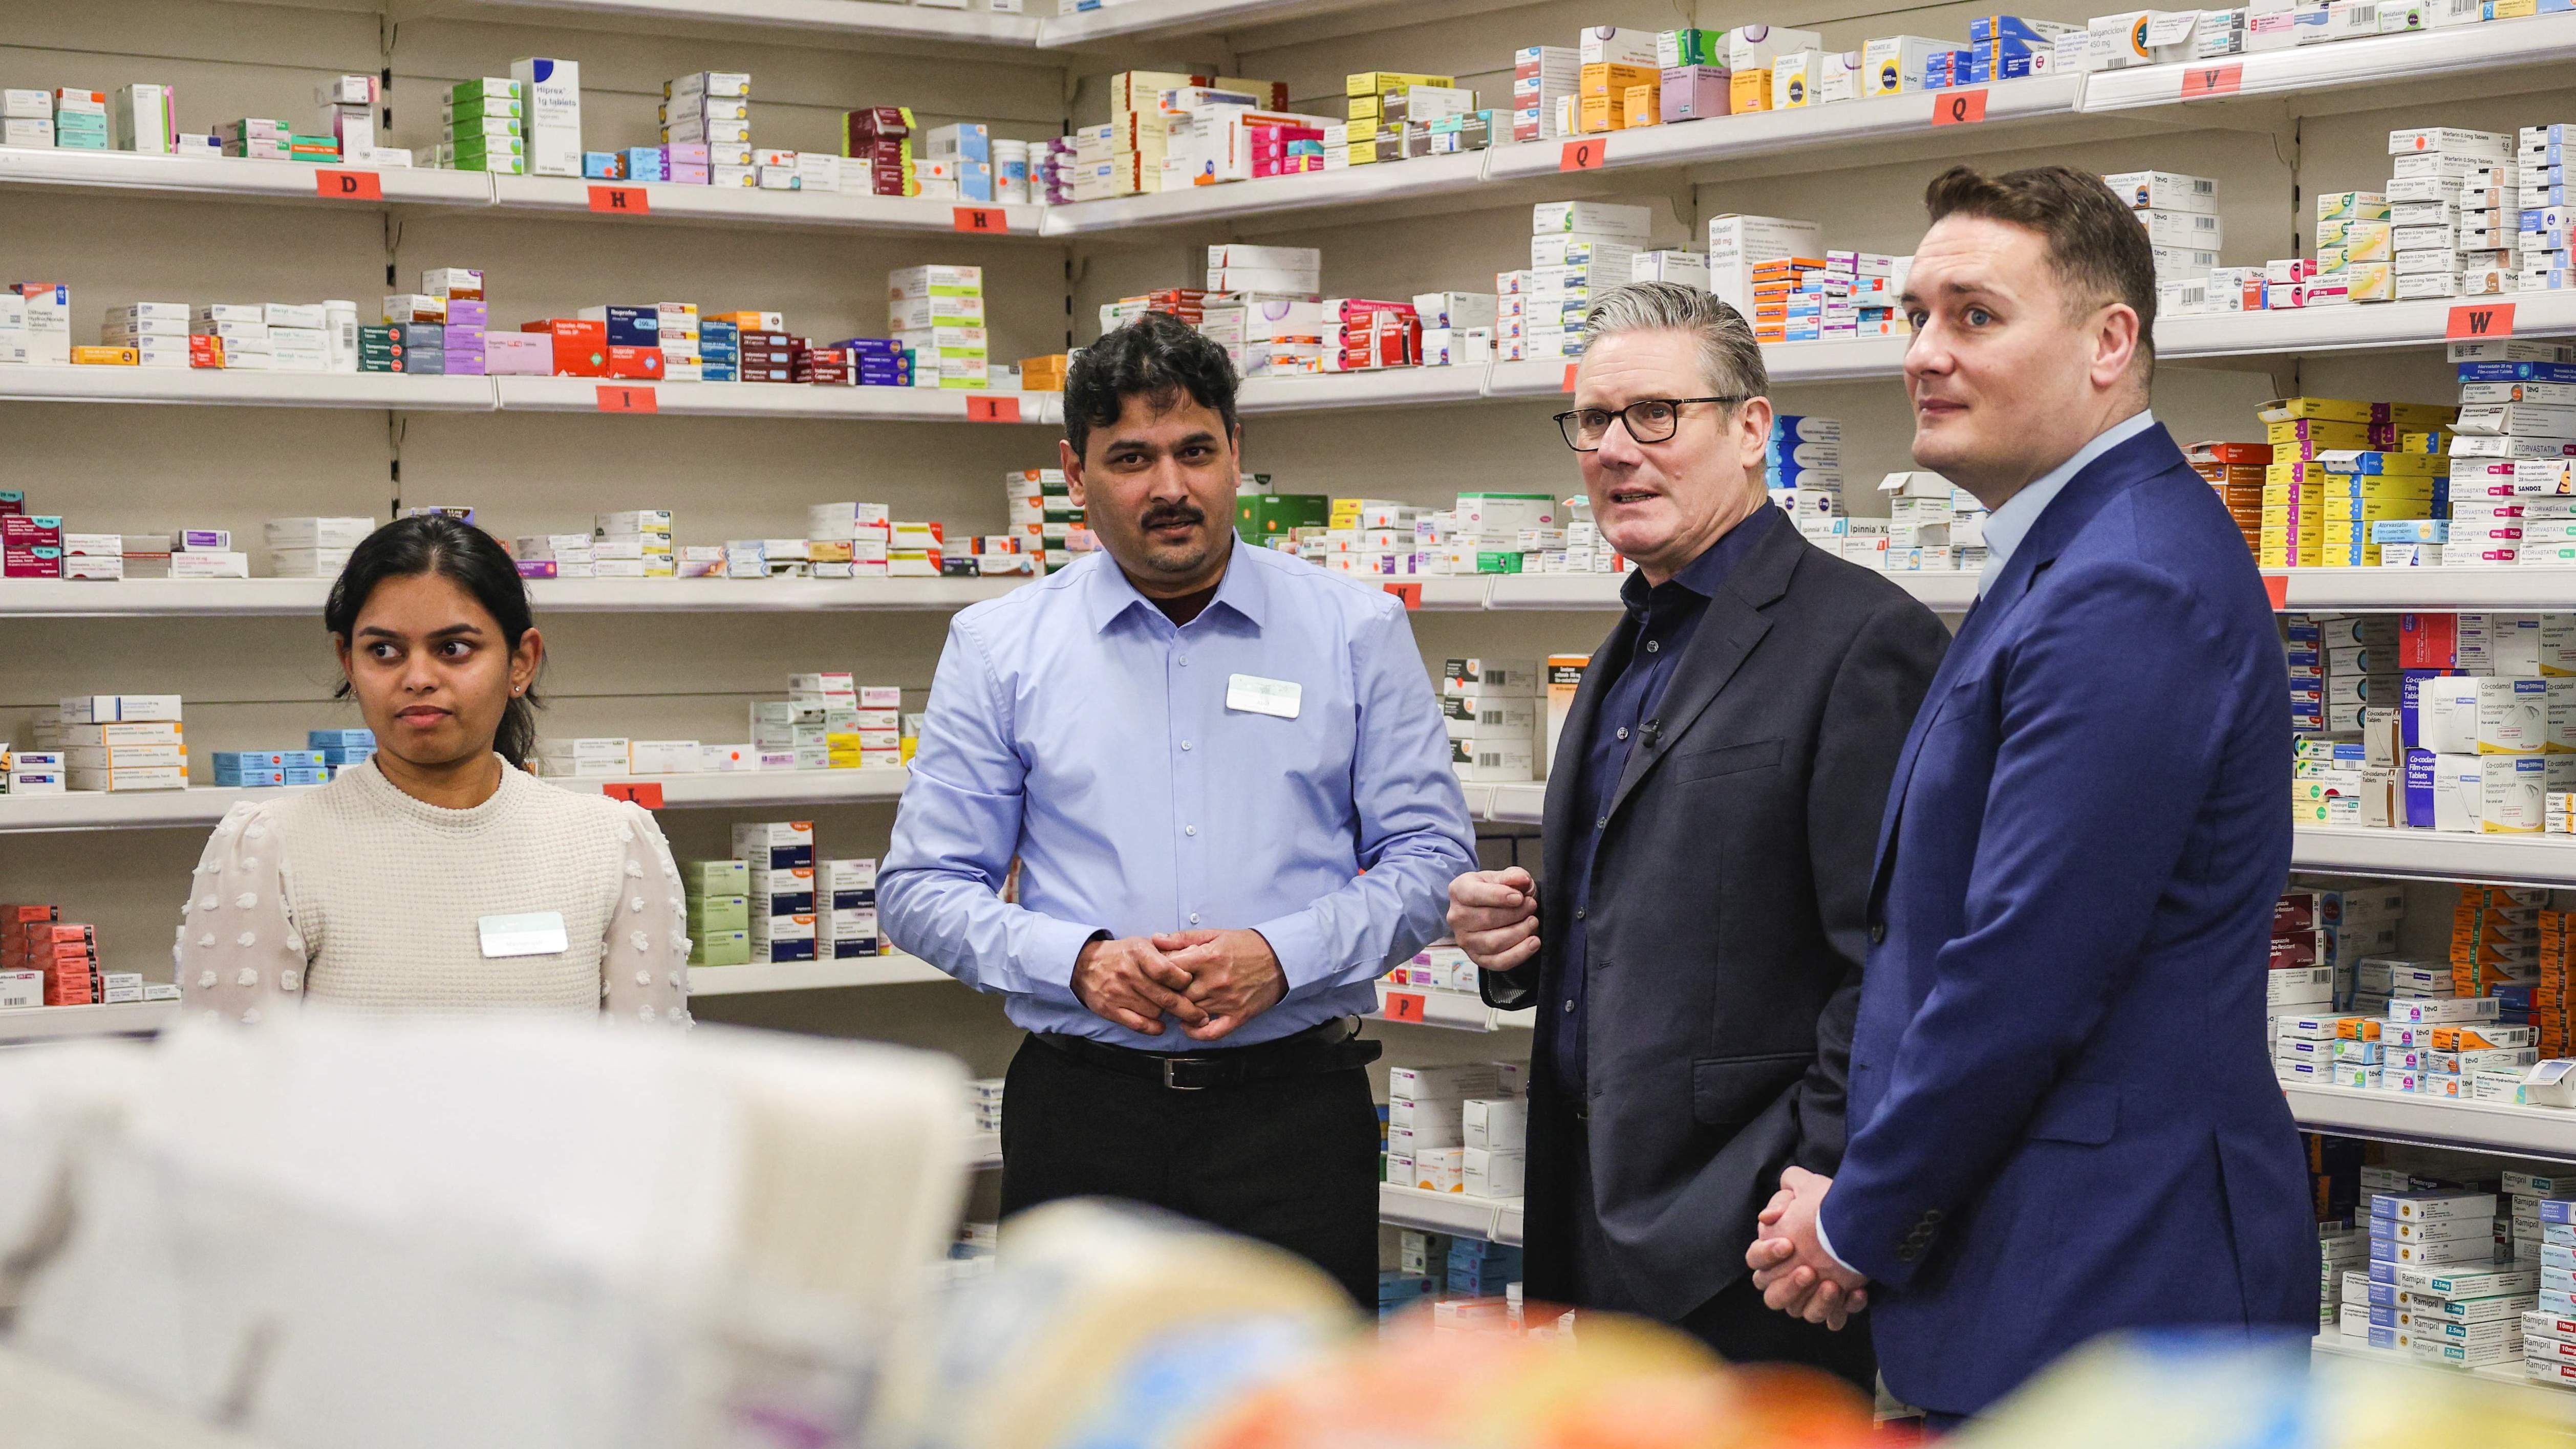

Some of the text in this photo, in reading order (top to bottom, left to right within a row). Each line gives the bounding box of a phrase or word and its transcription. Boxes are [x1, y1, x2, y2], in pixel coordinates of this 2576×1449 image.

[2090, 26, 2128, 37] Valganciclovir
[2205, 71, 2219, 91] V
[537, 85, 563, 94] Hiprex
[550, 98, 576, 106] tablets
[1952, 97, 1966, 121] Q
[1577, 146, 1588, 167] Q
[341, 177, 356, 192] D
[611, 192, 626, 207] H
[974, 212, 986, 227] H
[1711, 225, 1731, 234] Rifadin
[1712, 249, 1738, 258] Capsules
[2469, 311, 2493, 334] W
[623, 392, 630, 407] I
[990, 402, 997, 416] I
[1851, 525, 1875, 533] Ipinnia
[1399, 999, 1409, 1016] P
[2504, 1173, 2526, 1184] Ramipril
[2514, 1197, 2538, 1207] Ramipril
[2515, 1218, 2539, 1228] Ramipril
[2402, 1273, 2425, 1285] Ramipril
[2434, 1282, 2450, 1290] 2.5mg
[2414, 1297, 2438, 1308] Ramipril
[2415, 1318, 2439, 1330] Ramipril
[2523, 1314, 2548, 1326] Ramipril
[2559, 1323, 2573, 1331] 10mg
[2413, 1341, 2437, 1352] Ramipril
[2525, 1337, 2550, 1349] Ramipril
[2446, 1349, 2463, 1358] 2.5mg
[2562, 1346, 2576, 1354] 10mg
[2526, 1359, 2551, 1371] Ramipril
